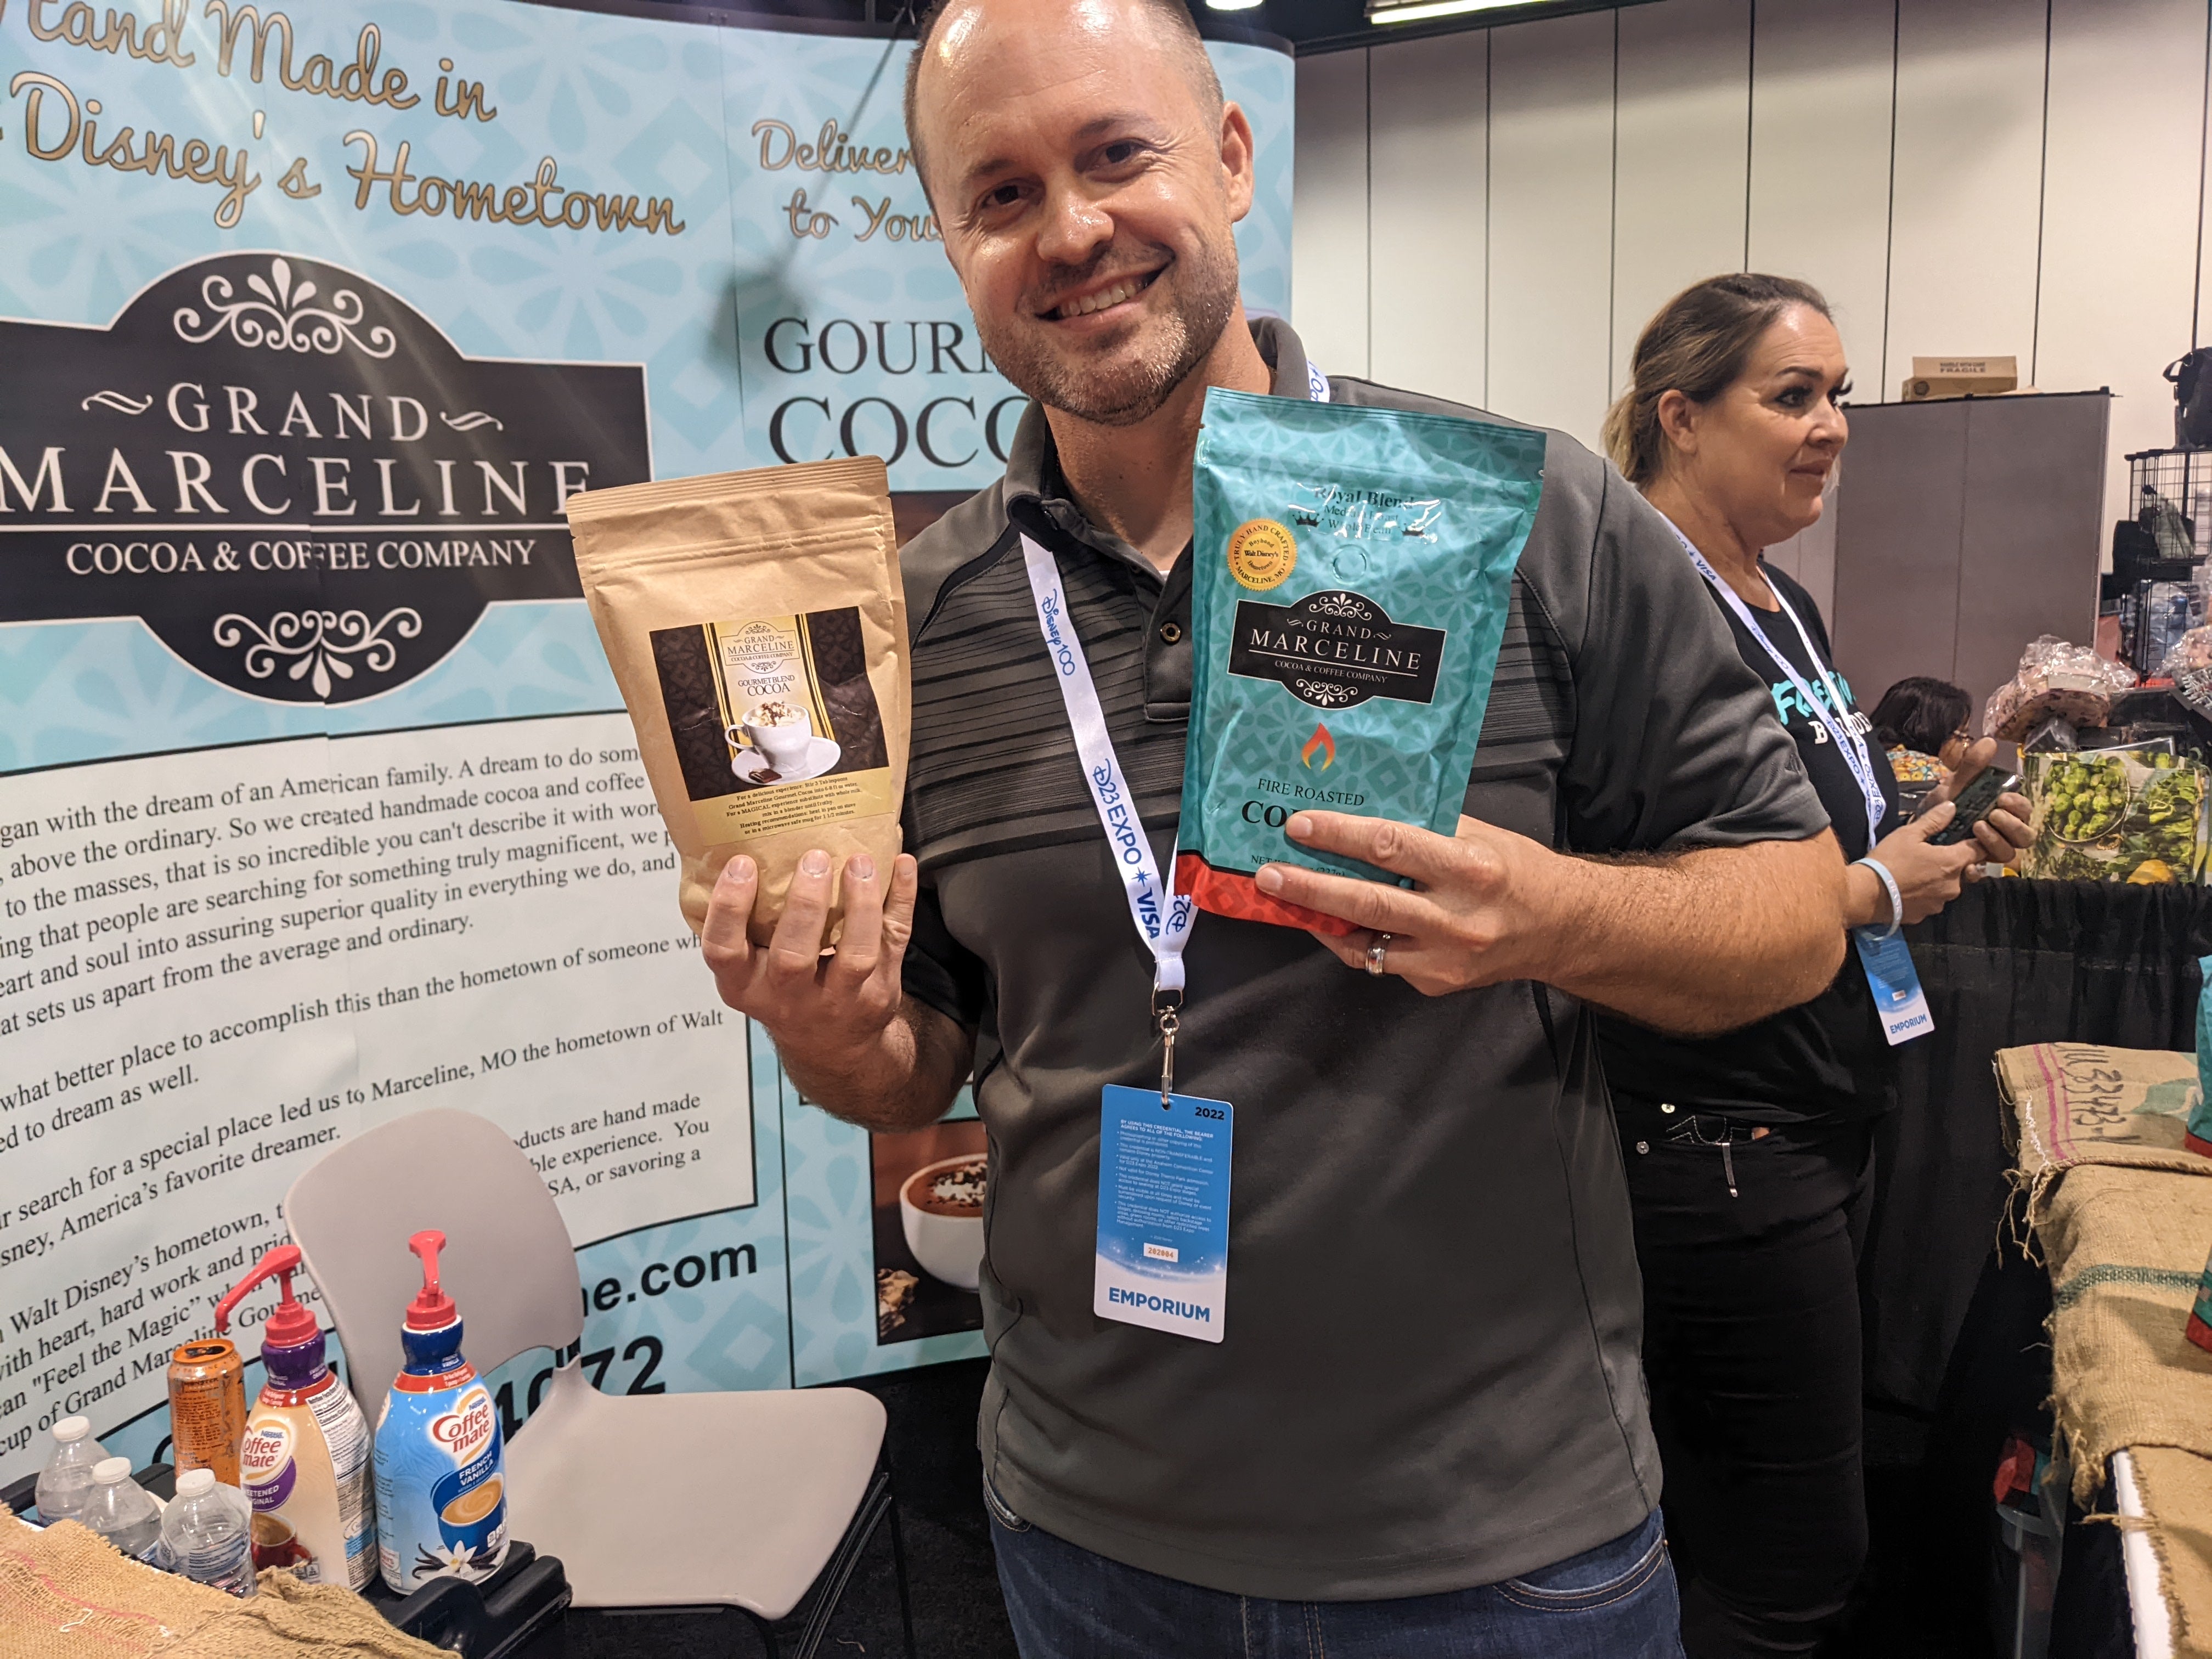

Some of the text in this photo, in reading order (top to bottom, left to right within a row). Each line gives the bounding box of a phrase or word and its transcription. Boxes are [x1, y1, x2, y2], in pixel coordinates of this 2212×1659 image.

[204, 0, 420, 109] Made
[435, 58, 497, 122] in
[10, 71, 685, 235] Disney's Hometown
[752, 119, 915, 174] Deliver
[783, 188, 942, 242] to You
[764, 318, 993, 375] GOUR
[167, 382, 428, 441] GRAND
[770, 397, 1029, 467] COCO
[0, 445, 590, 516] MARCELINE
[66, 539, 537, 574] COCOA & COFFEE COMPANY
[1234, 525, 1289, 561] TRULY HAND CRAFTED
[1274, 568, 1285, 578] MO
[727, 641, 794, 654] MARCELINE
[744, 635, 775, 644] GRAND
[1306, 619, 1371, 640] GRAND
[1250, 628, 1421, 670] MARCELINE
[738, 675, 795, 687] GOURMET BLEND
[747, 682, 791, 697] COCOA
[1274, 659, 1304, 671] COCOA
[1313, 665, 1345, 677] COFFEE
[1346, 671, 1388, 684] COMPANY
[1839, 740, 1861, 775] EXPO
[46, 805, 97, 833] with
[104, 801, 137, 823] the
[146, 794, 213, 816] dream
[221, 783, 245, 805] of
[250, 786, 274, 802] an
[280, 774, 379, 798] American
[387, 763, 452, 787] family.
[459, 760, 474, 778] A
[480, 757, 538, 775] dream
[545, 754, 562, 768] to
[569, 748, 592, 765] do
[600, 749, 637, 763] som
[741, 804, 770, 814] MAGICAL
[772, 799, 798, 808] experience
[1257, 778, 1364, 806] FIRE ROASTED
[1242, 800, 1296, 828] CO
[1107, 804, 1142, 865] EXPO
[1137, 887, 1160, 939] VISA
[0, 932, 701, 1111] what better place to accomplish this than the hometown of someone wh
[1890, 1013, 1927, 1035] EMPORIUM
[19, 1009, 723, 1221] search for a special place led us to Marceline, MO the hometown of Walt
[1195, 1107, 1224, 1120] 2022
[530, 1120, 709, 1172] ble experience. You
[61, 1182, 158, 1240] America’s
[165, 1154, 244, 1193] favorite
[252, 1127, 340, 1163] dreamer.
[549, 1149, 701, 1196] SA, or savoring a
[38, 1230, 291, 1359] heart, hard work and prid
[581, 1243, 757, 1317] e.com
[1109, 1286, 1210, 1322] EMPORIUM
[244, 1426, 281, 1454] offee
[433, 1404, 488, 1442] Coffee
[453, 1419, 489, 1453] mate
[243, 1454, 275, 1467] mate
[459, 1451, 492, 1480] FRENCH
[460, 1459, 493, 1486] VANILLA
[246, 1485, 279, 1497] EETENED
